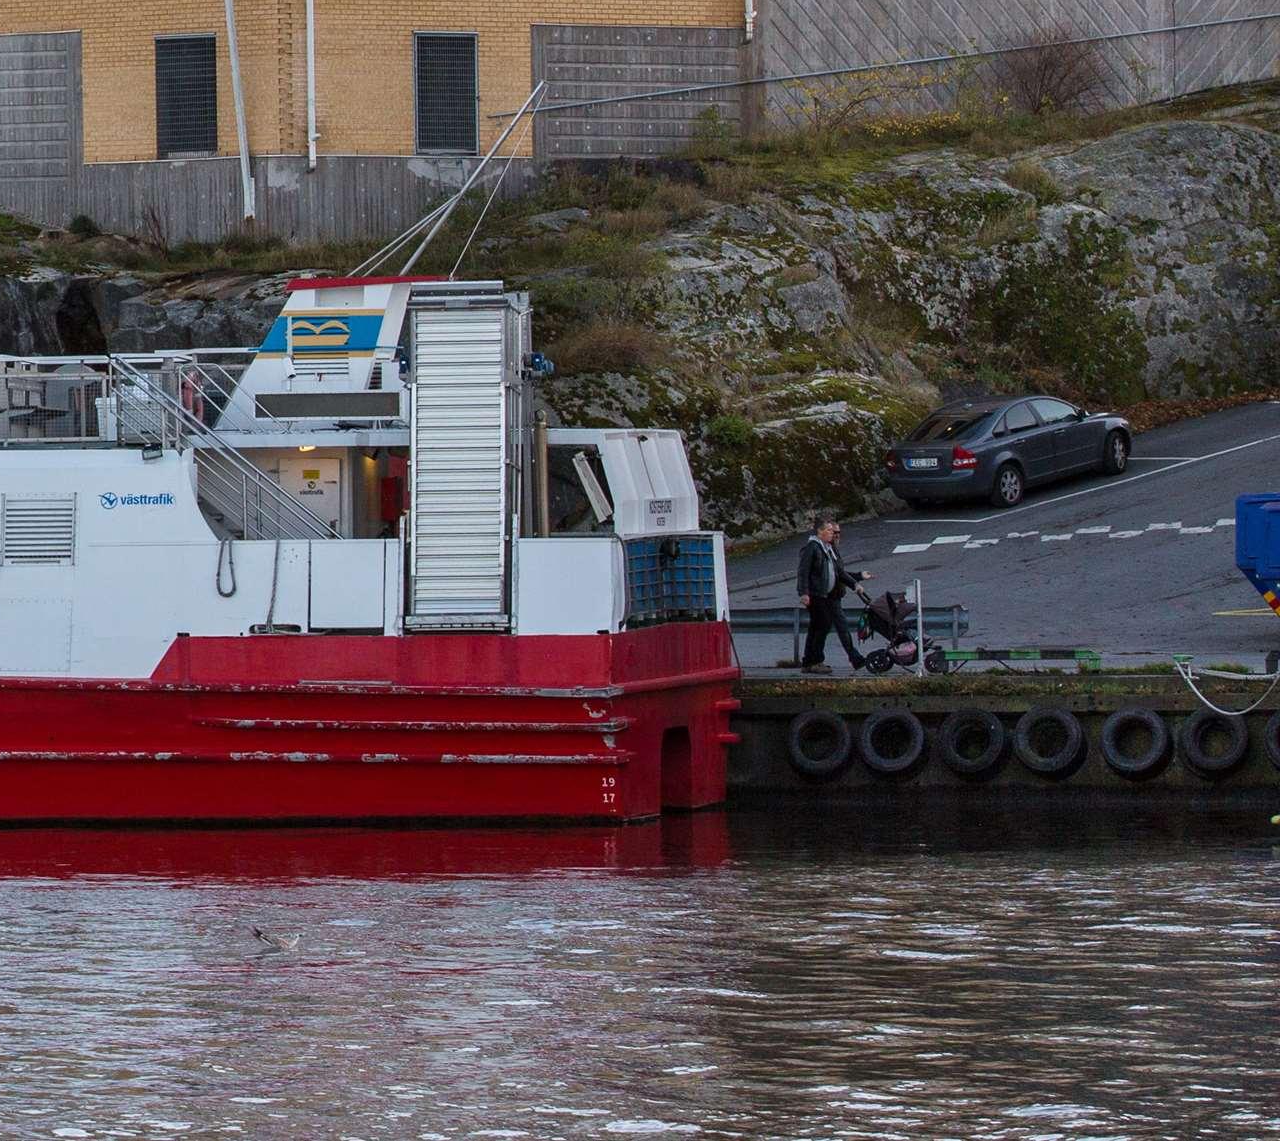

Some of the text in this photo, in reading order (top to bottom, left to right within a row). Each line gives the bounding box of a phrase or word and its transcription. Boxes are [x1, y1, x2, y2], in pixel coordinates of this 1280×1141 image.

[120, 492, 174, 506] västtrafik
[602, 777, 615, 787] 19
[603, 793, 615, 803] 17
